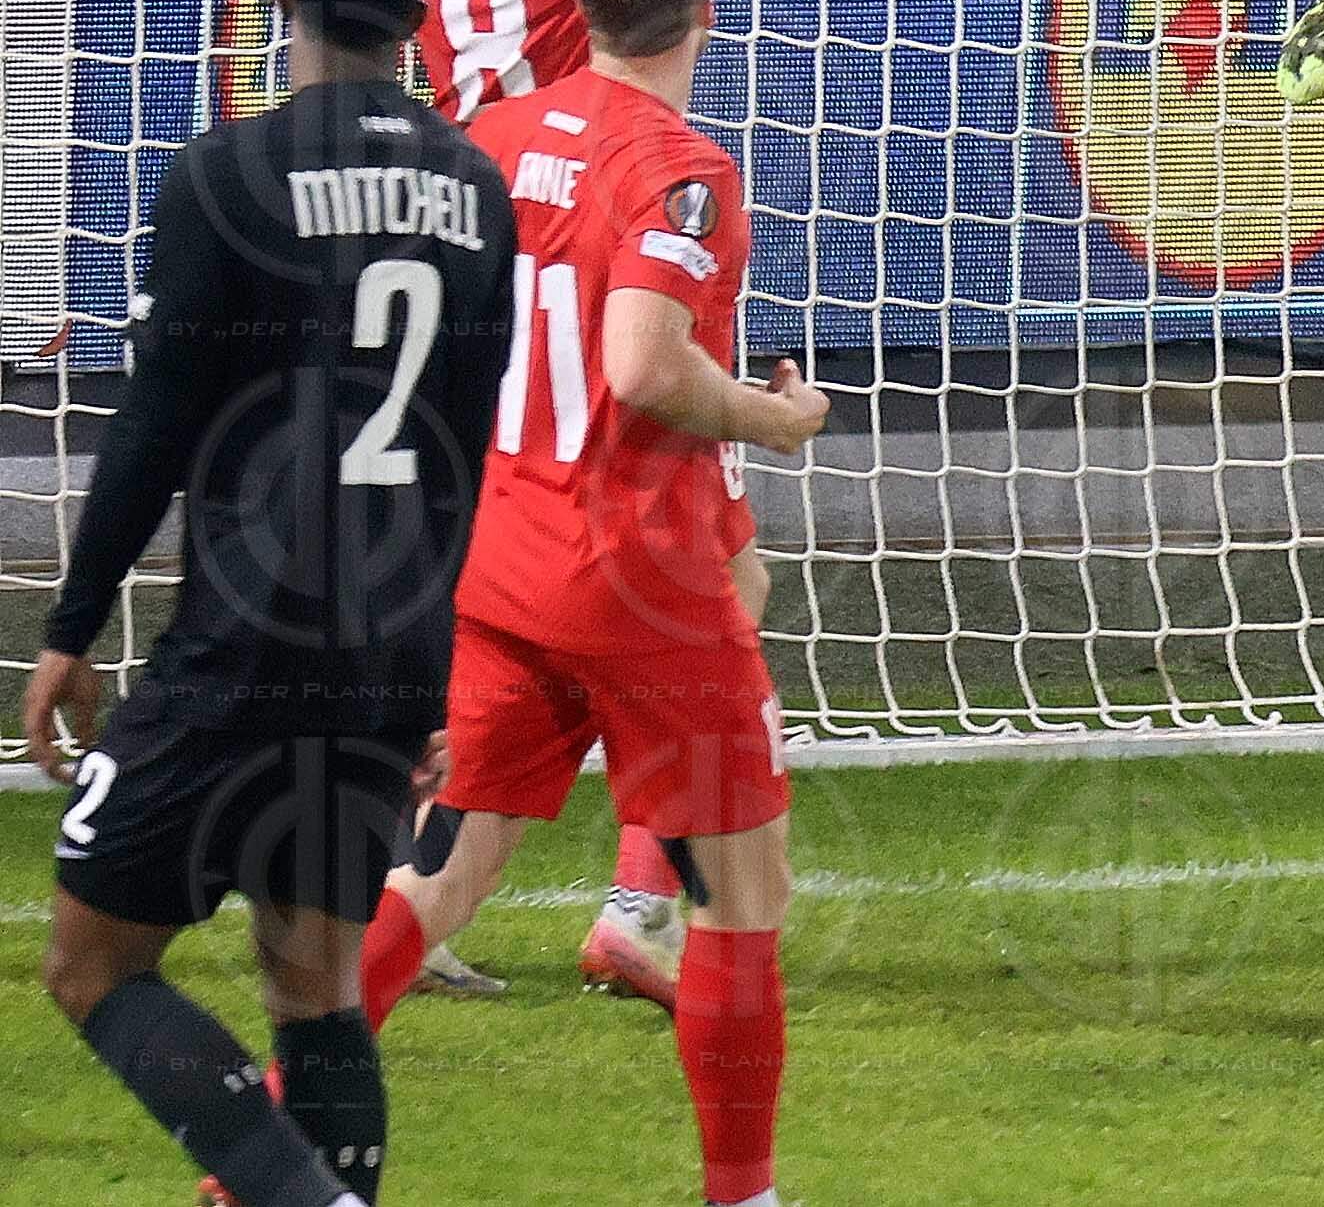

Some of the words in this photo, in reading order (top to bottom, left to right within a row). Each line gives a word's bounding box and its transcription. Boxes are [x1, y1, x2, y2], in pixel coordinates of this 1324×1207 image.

[287, 167, 485, 251] MITCHELL
[339, 260, 445, 486] 2
[496, 252, 590, 463] 11
[61, 750, 119, 846] 2
